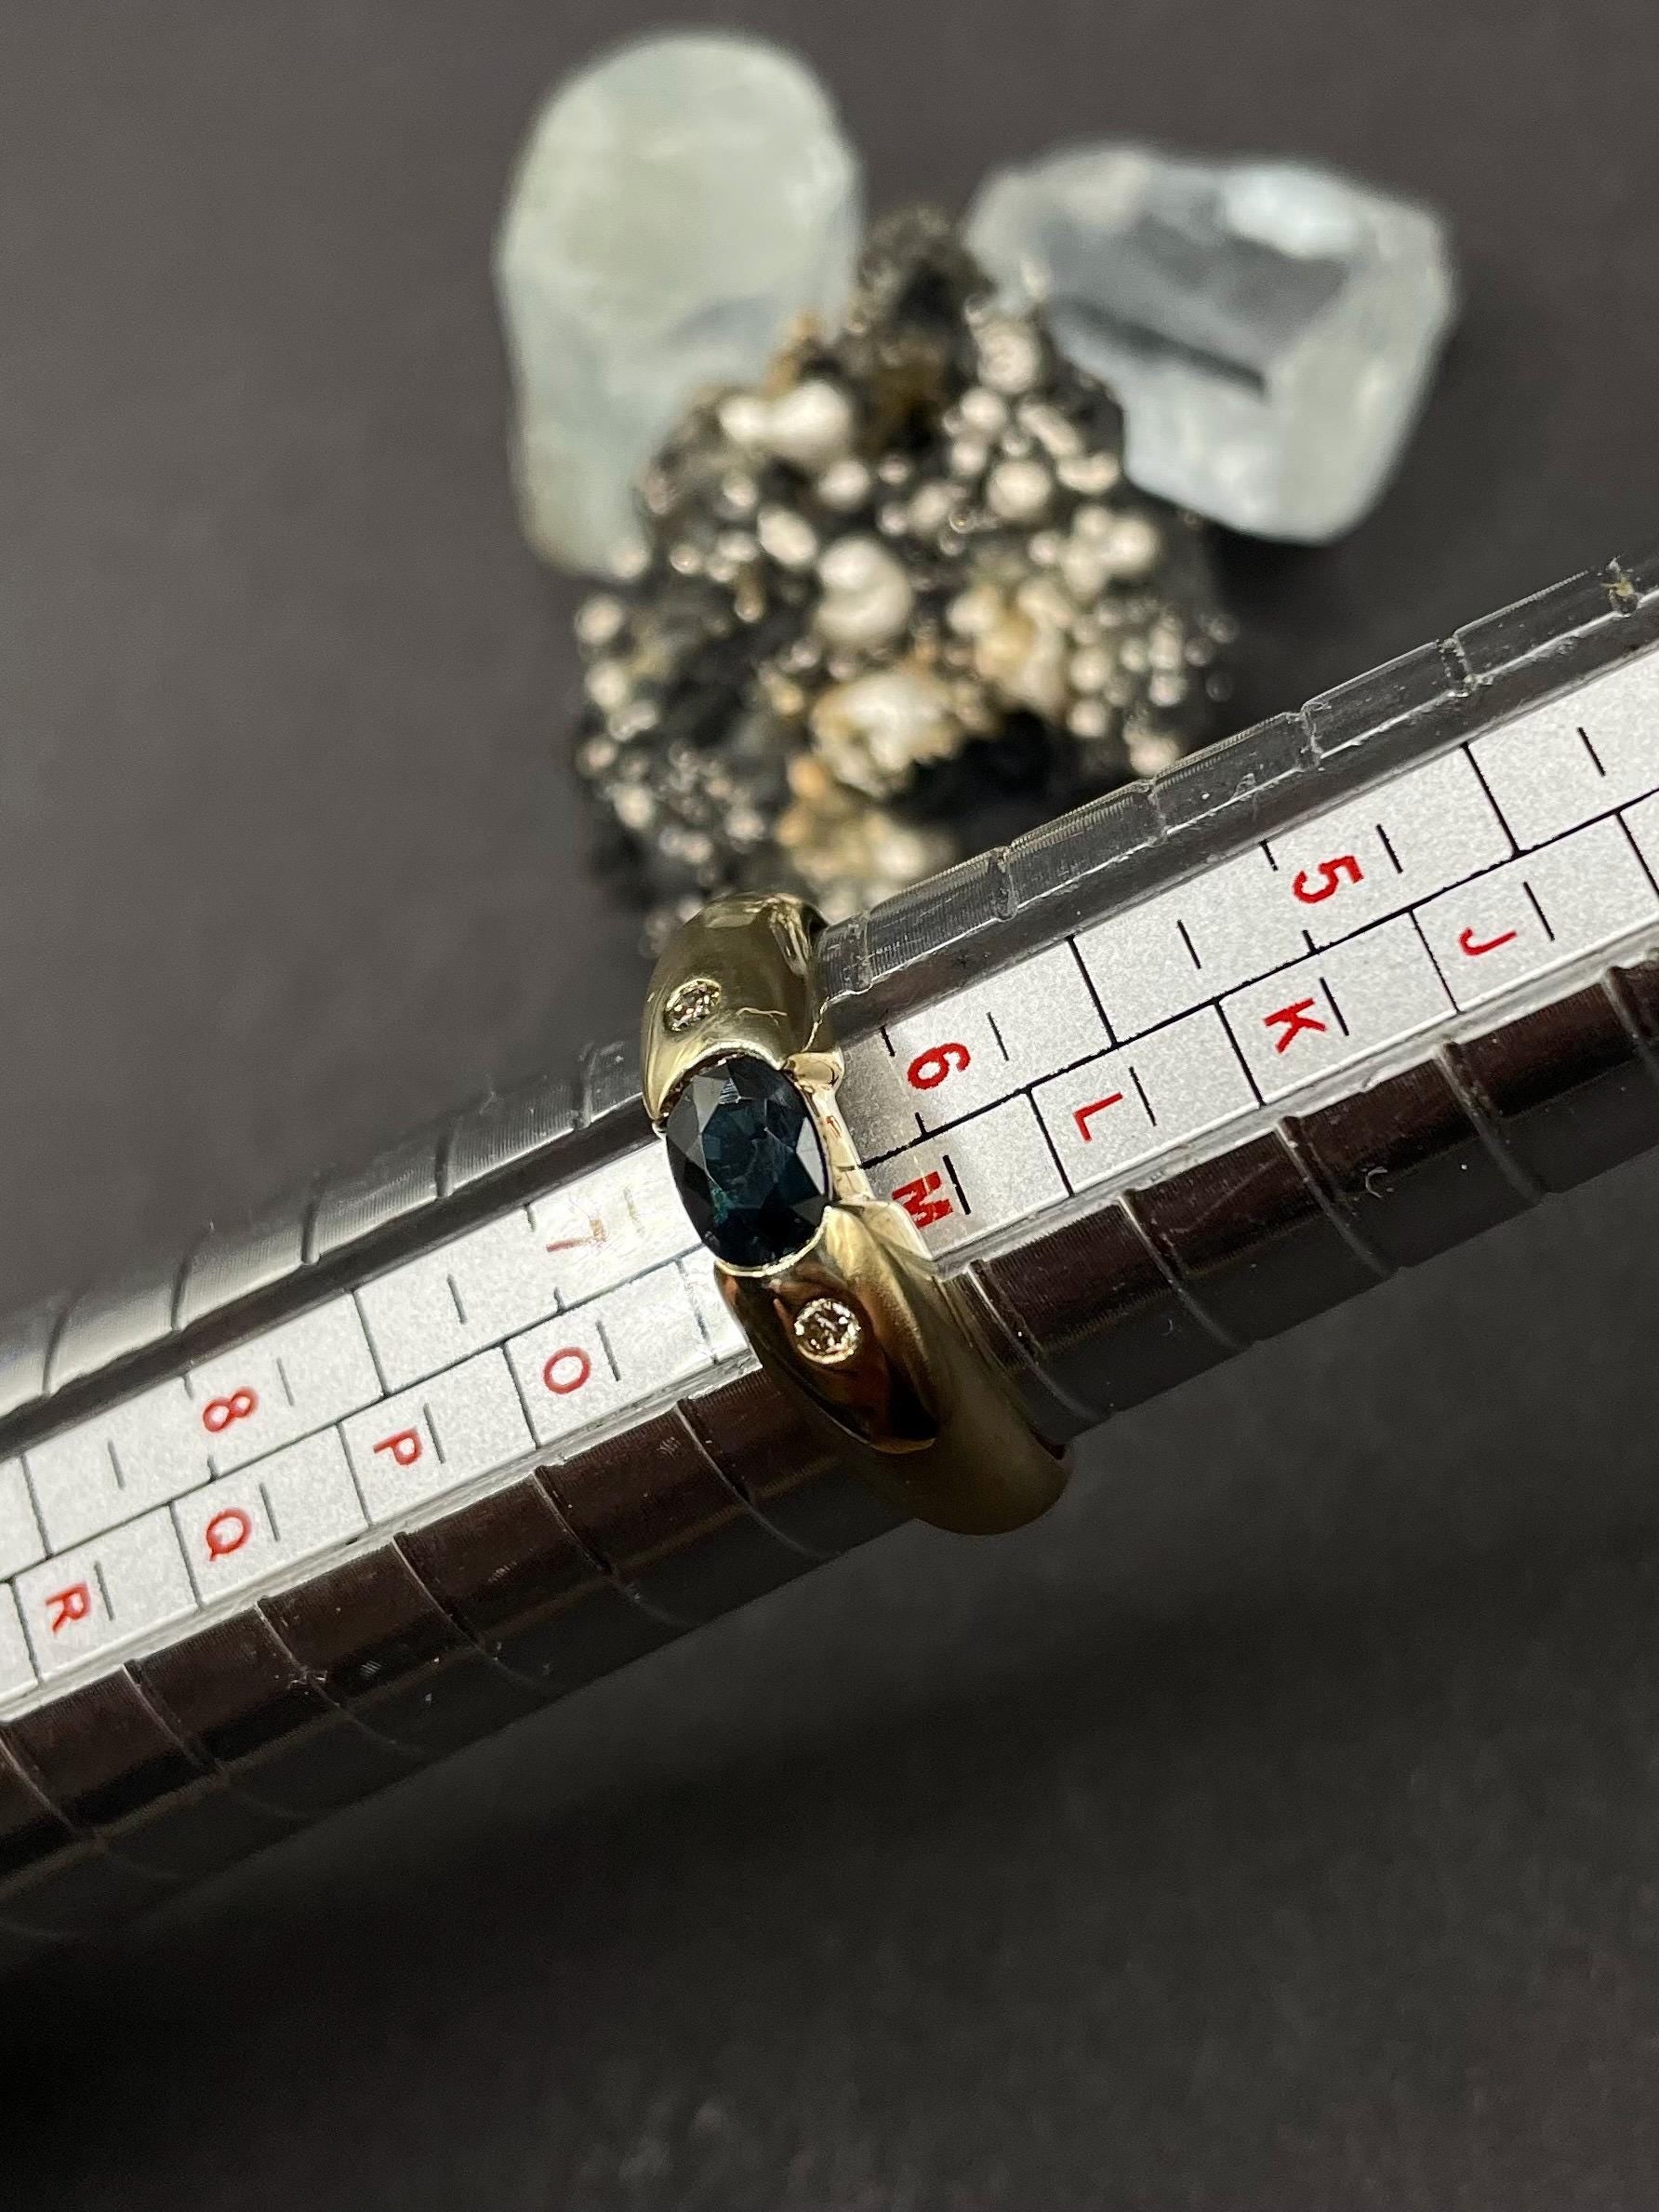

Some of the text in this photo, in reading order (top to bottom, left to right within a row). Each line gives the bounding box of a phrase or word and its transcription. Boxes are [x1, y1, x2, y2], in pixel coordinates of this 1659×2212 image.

[1293, 854, 1364, 905] 5
[1458, 927, 1518, 957] J
[1264, 997, 1326, 1054] K
[907, 1042, 972, 1091] 6
[1072, 1092, 1124, 1143] L
[892, 1171, 953, 1230] M
[202, 1387, 258, 1433] 8
[373, 1428, 421, 1466] P
[205, 1508, 252, 1562] Q
[46, 1581, 92, 1632] R
